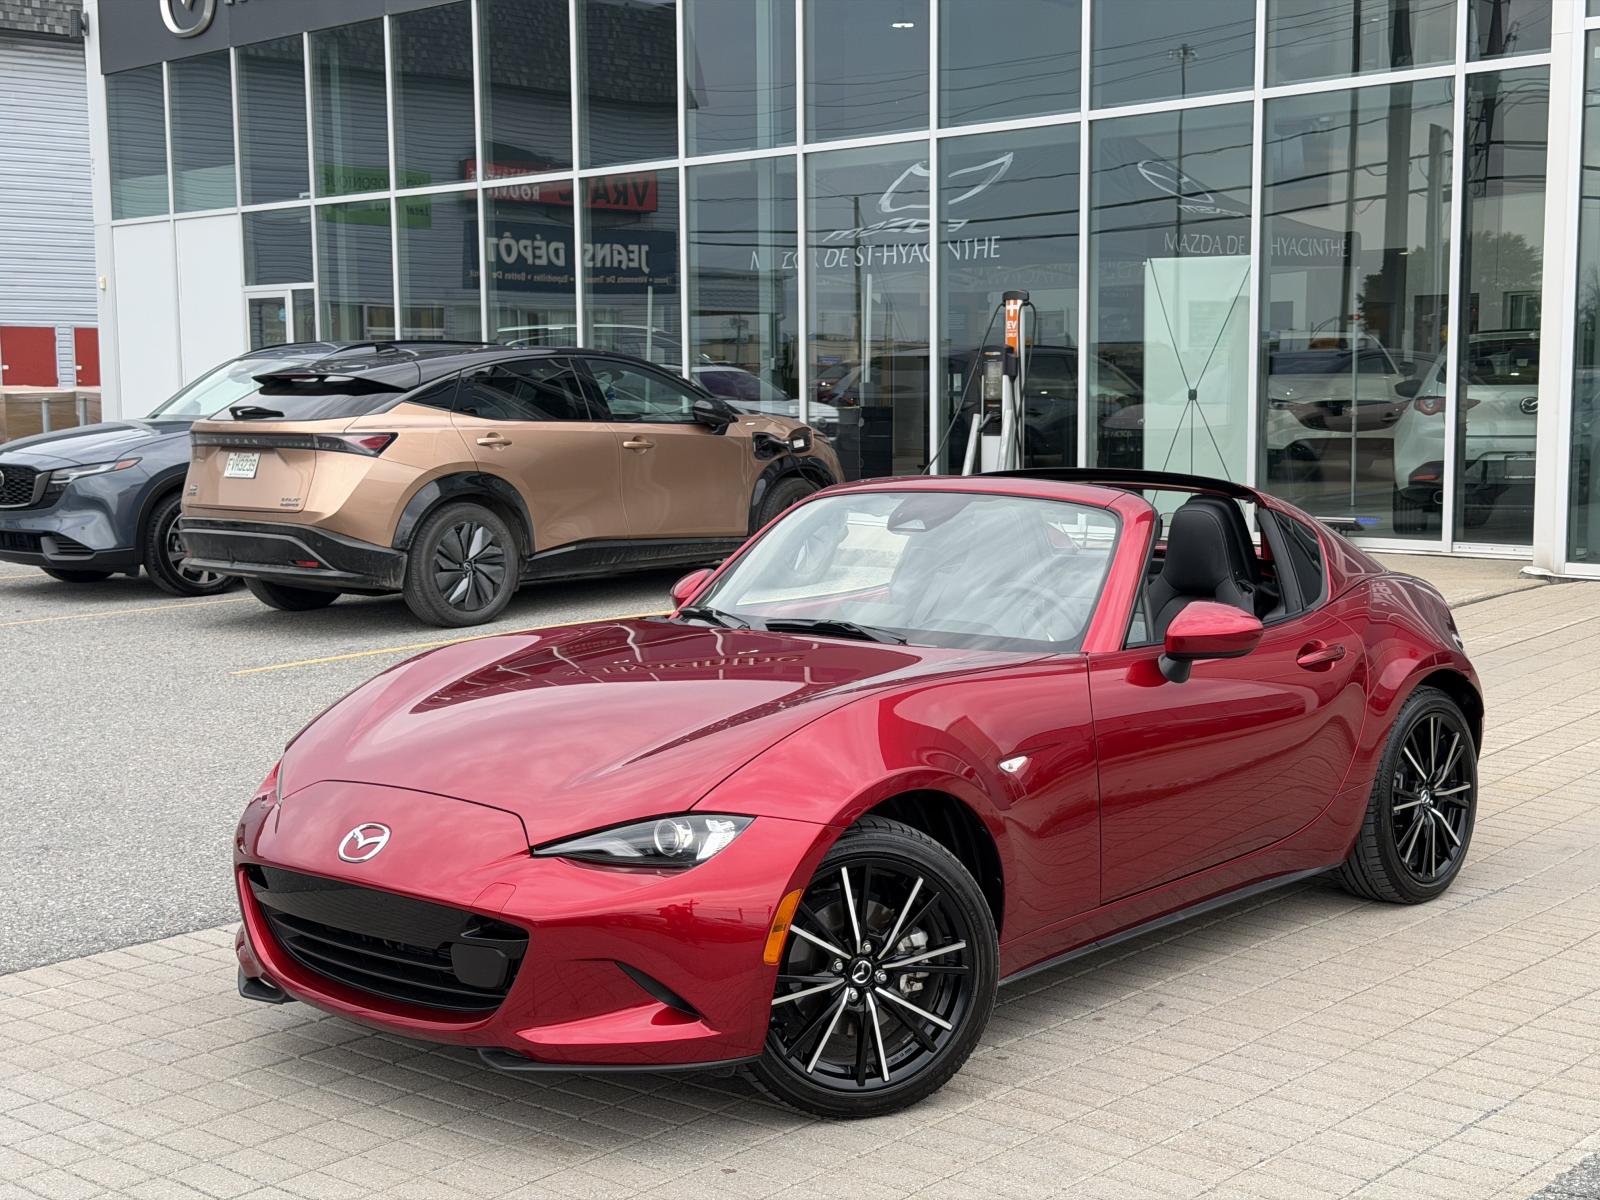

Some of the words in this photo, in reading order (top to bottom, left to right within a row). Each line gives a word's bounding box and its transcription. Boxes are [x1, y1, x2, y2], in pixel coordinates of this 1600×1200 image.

[824, 248, 849, 268] DE
[854, 235, 1001, 267] ST-HYACNTHE
[1164, 232, 1222, 254] MAZDA
[1226, 235, 1246, 255] DE
